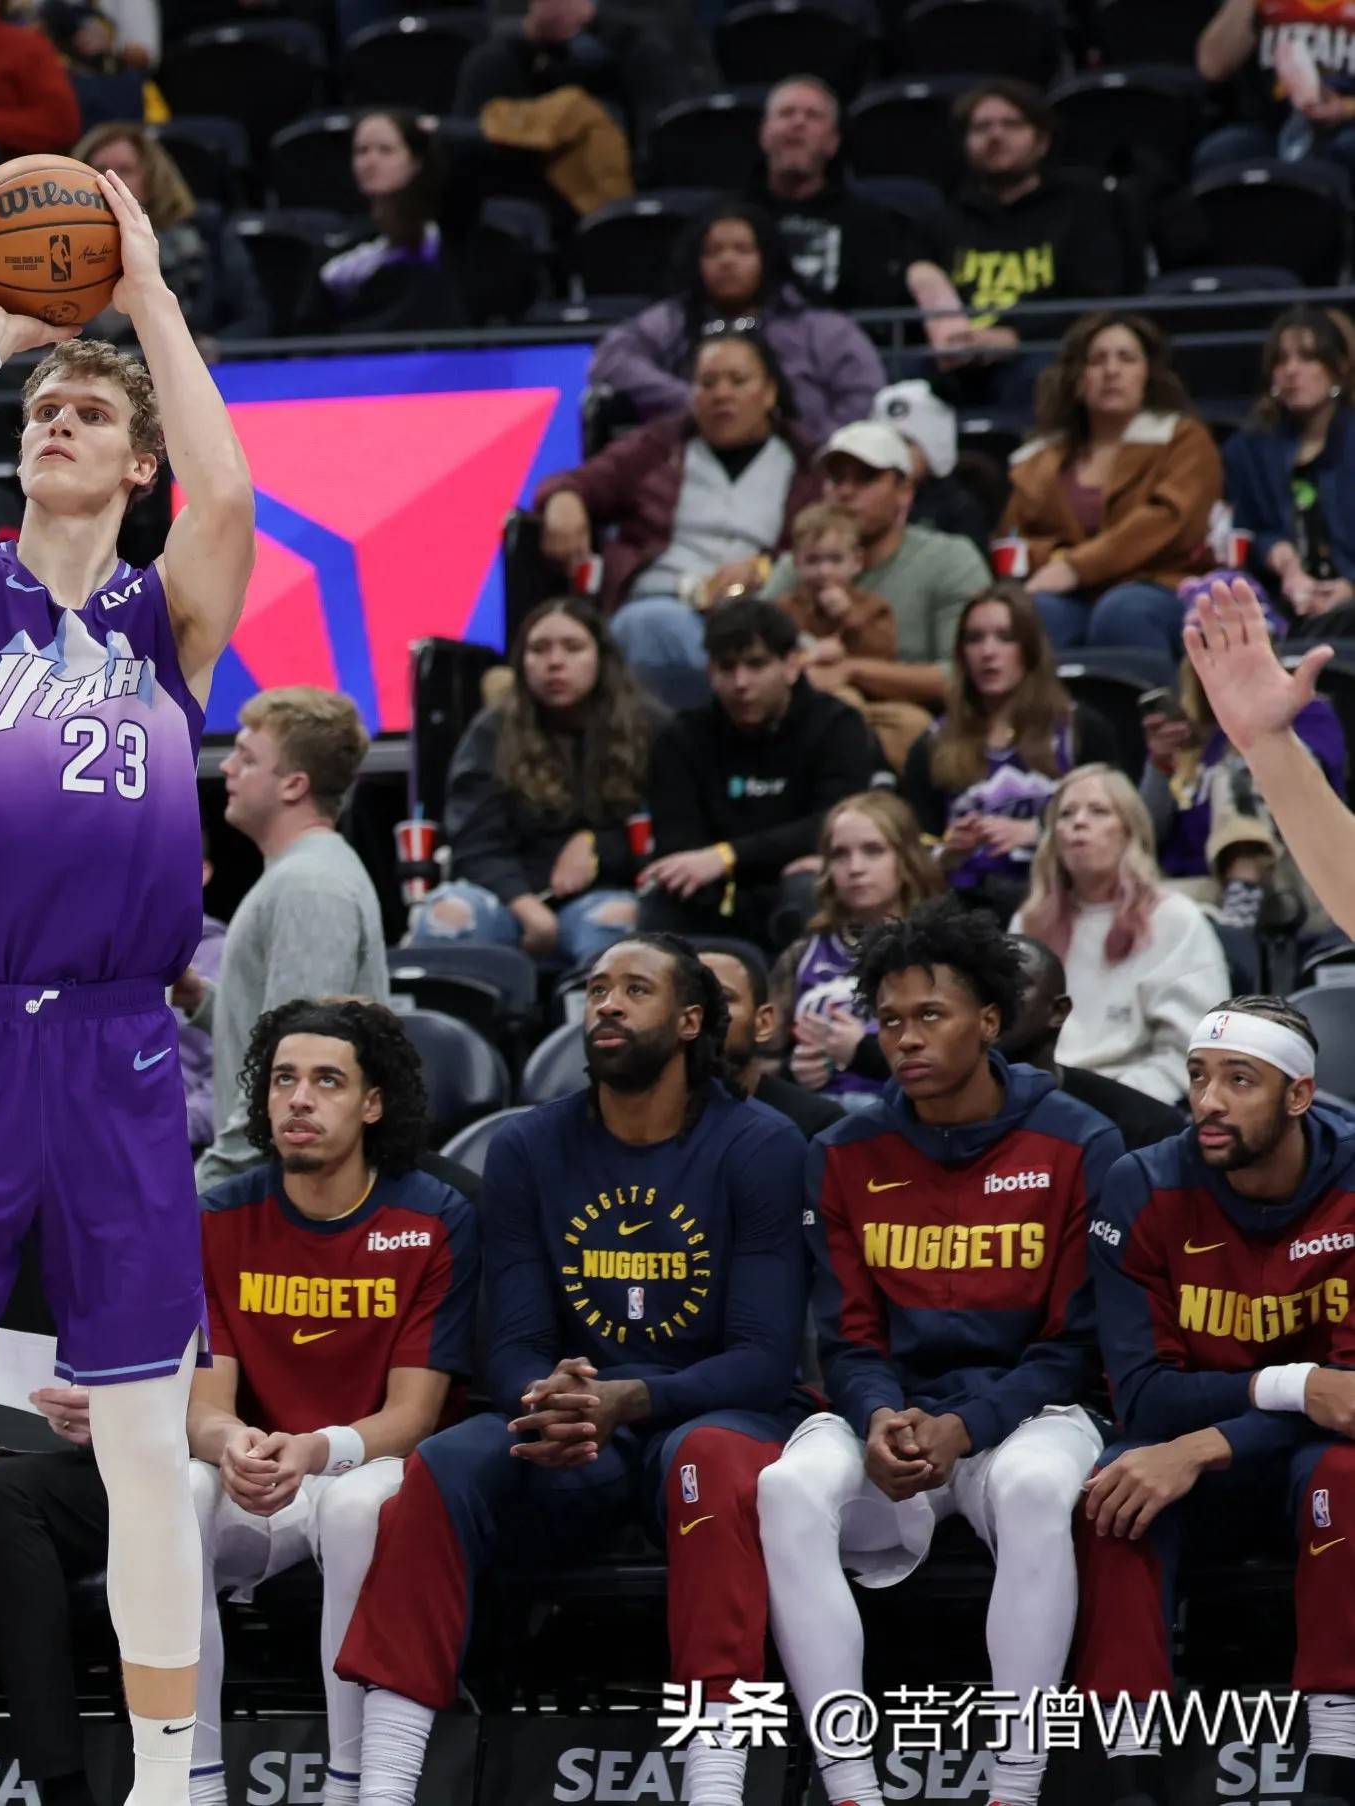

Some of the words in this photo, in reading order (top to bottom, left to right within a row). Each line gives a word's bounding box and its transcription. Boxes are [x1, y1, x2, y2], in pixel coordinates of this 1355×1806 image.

[100, 577, 143, 610] LVT
[61, 715, 148, 800] 23
[984, 1170, 1050, 1194] ibotta
[367, 1230, 431, 1251] ibotta
[862, 1222, 1045, 1270] NUGGETS
[1289, 1232, 1355, 1261] ibotta
[582, 1250, 687, 1280] NUGGETS
[238, 1271, 396, 1319] NUGGETS
[1179, 1277, 1350, 1344] NUGGETS
